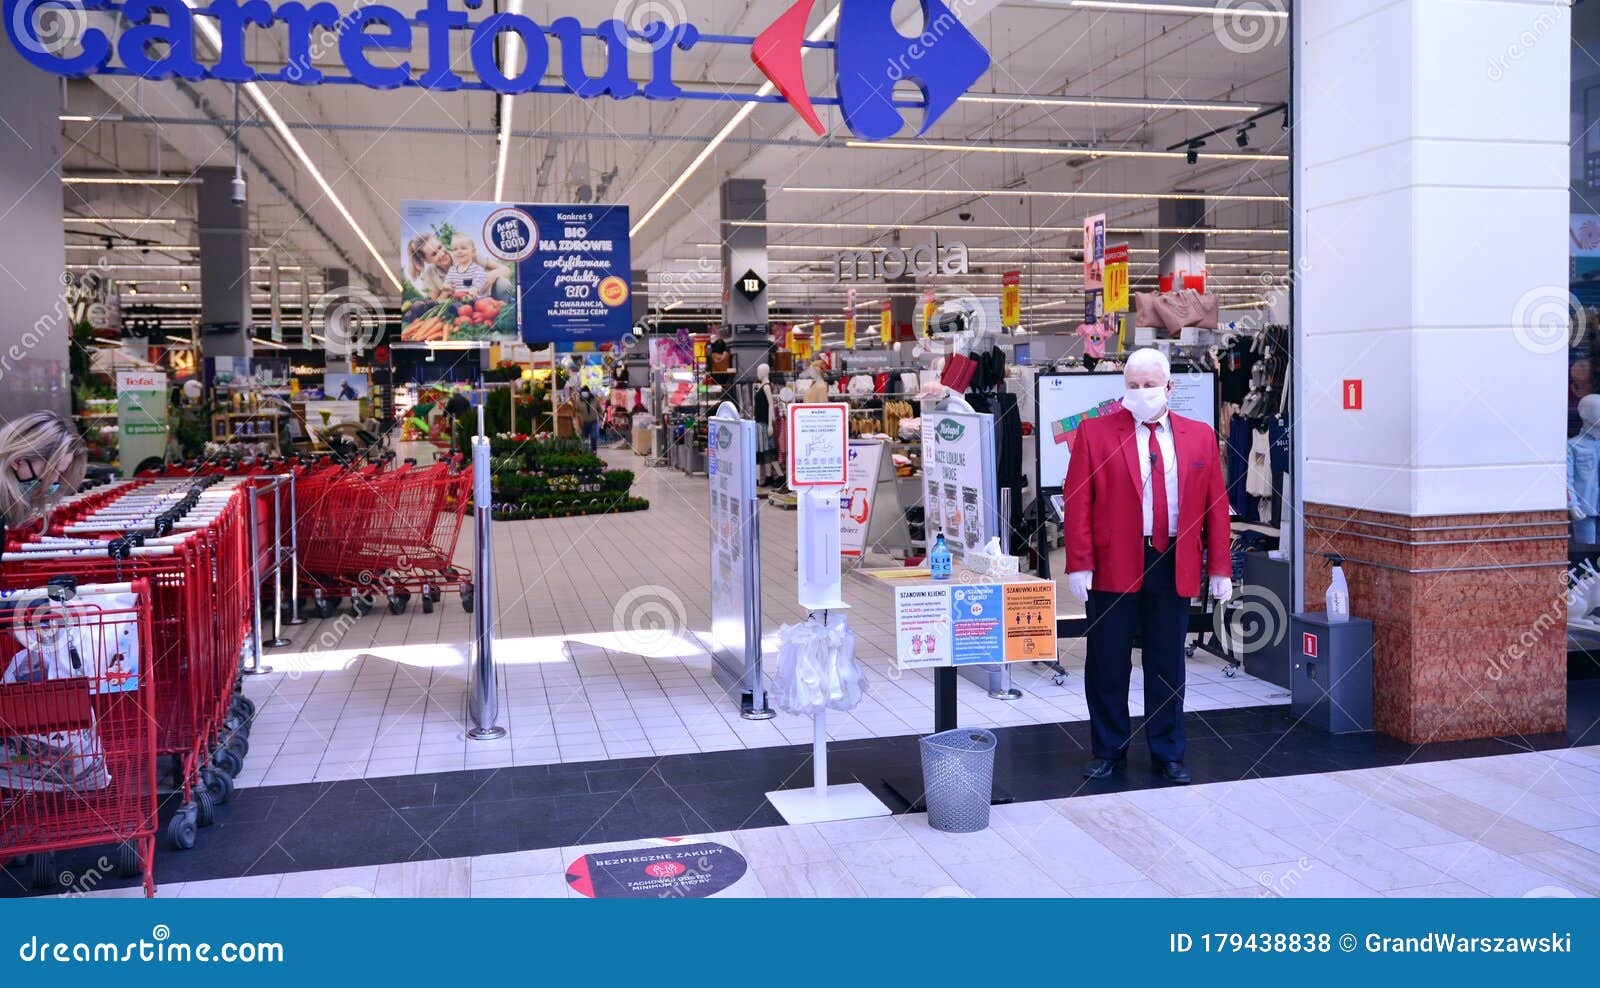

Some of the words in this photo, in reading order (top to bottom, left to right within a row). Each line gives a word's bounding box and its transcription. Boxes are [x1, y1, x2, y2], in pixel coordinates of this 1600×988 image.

[556, 212, 587, 221] Konkret
[587, 212, 593, 221] 9
[563, 227, 588, 239] BIO
[539, 240, 558, 252] NA
[558, 239, 613, 252] ZDROWIE
[543, 254, 612, 273] certyfikowane
[832, 231, 969, 284] moda
[554, 269, 601, 288] produkty
[564, 284, 590, 298] BIO
[743, 279, 760, 292] TEX
[559, 300, 604, 309] GWARANCJĄ
[547, 308, 590, 317] NAJNIŻSZEJ
[590, 308, 609, 316] CENY
[125, 377, 154, 386] Tefal
[900, 591, 927, 599] SZANOWNI
[1006, 586, 1033, 594] SZANOWNI
[595, 854, 673, 867] BEZPIECZNE
[676, 848, 723, 859] ZAKUPY
[632, 882, 677, 892] MINIMUM
